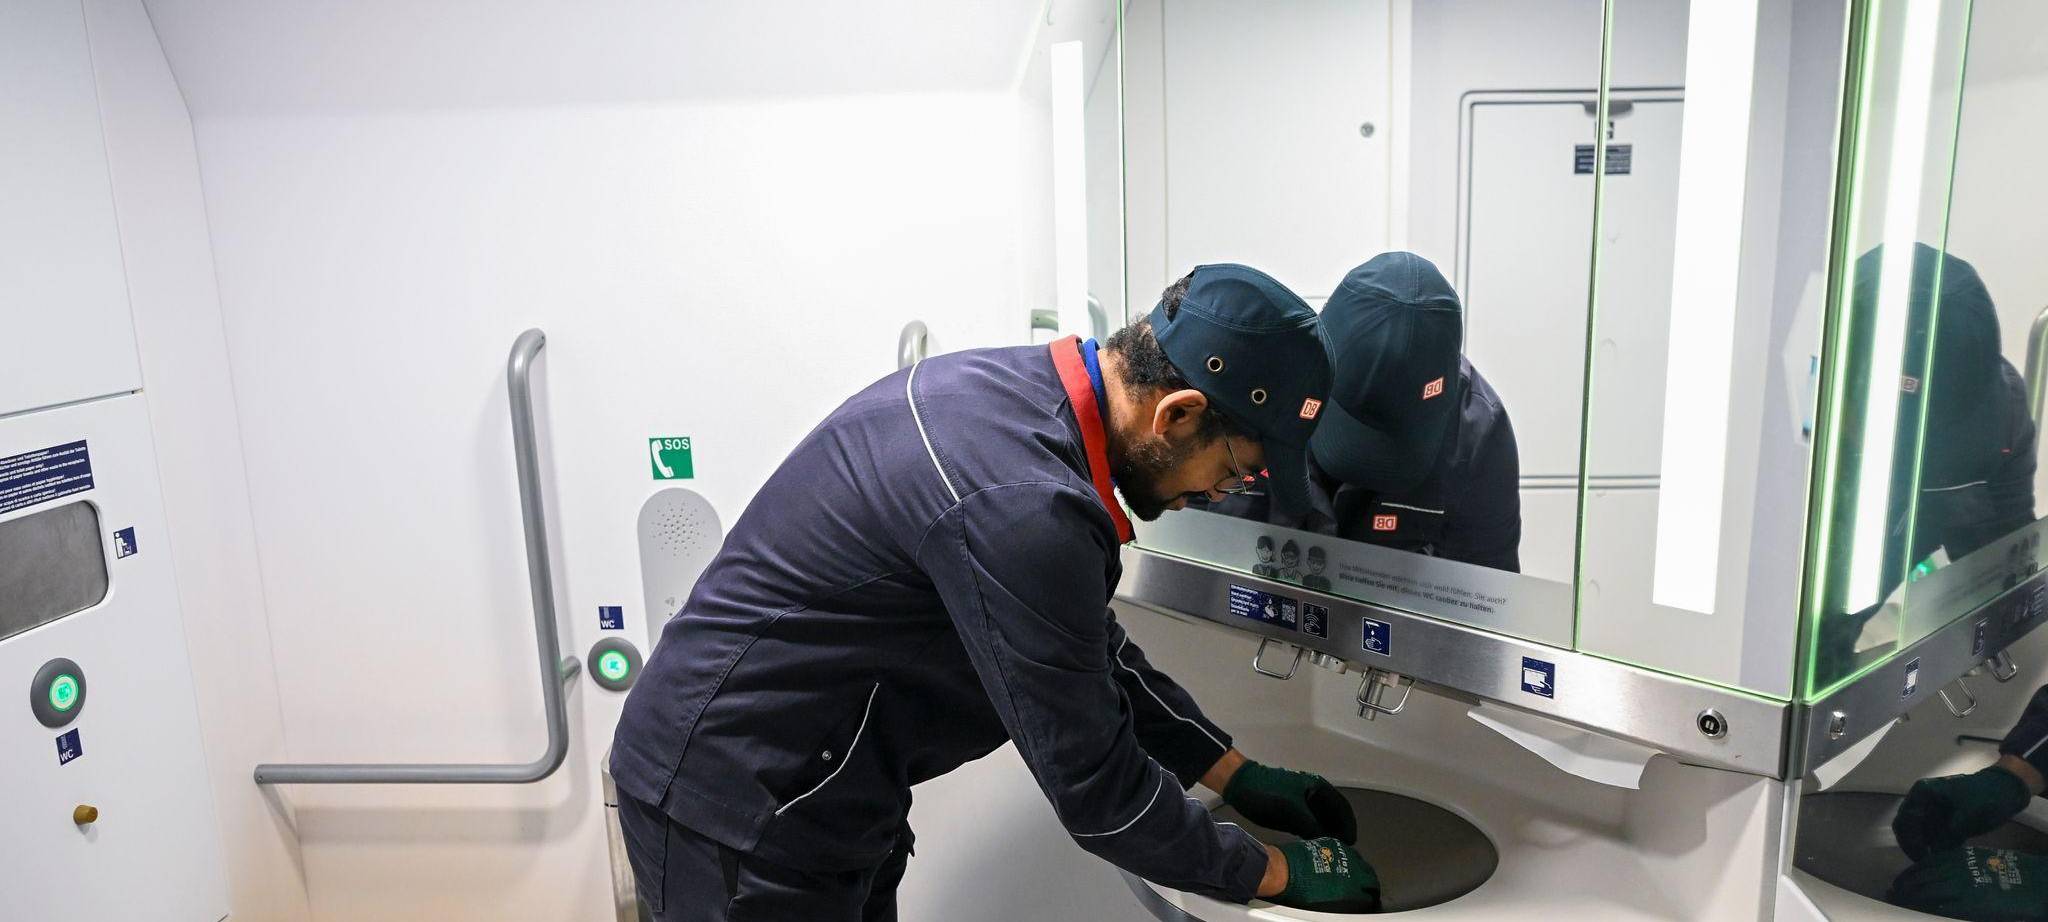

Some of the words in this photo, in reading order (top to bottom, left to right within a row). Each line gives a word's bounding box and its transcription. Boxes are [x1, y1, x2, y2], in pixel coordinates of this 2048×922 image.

[1301, 400, 1319, 417] DB
[664, 438, 690, 451] SOS
[1422, 591, 1433, 600] WC
[601, 620, 615, 629] WC
[60, 749, 74, 762] WC
